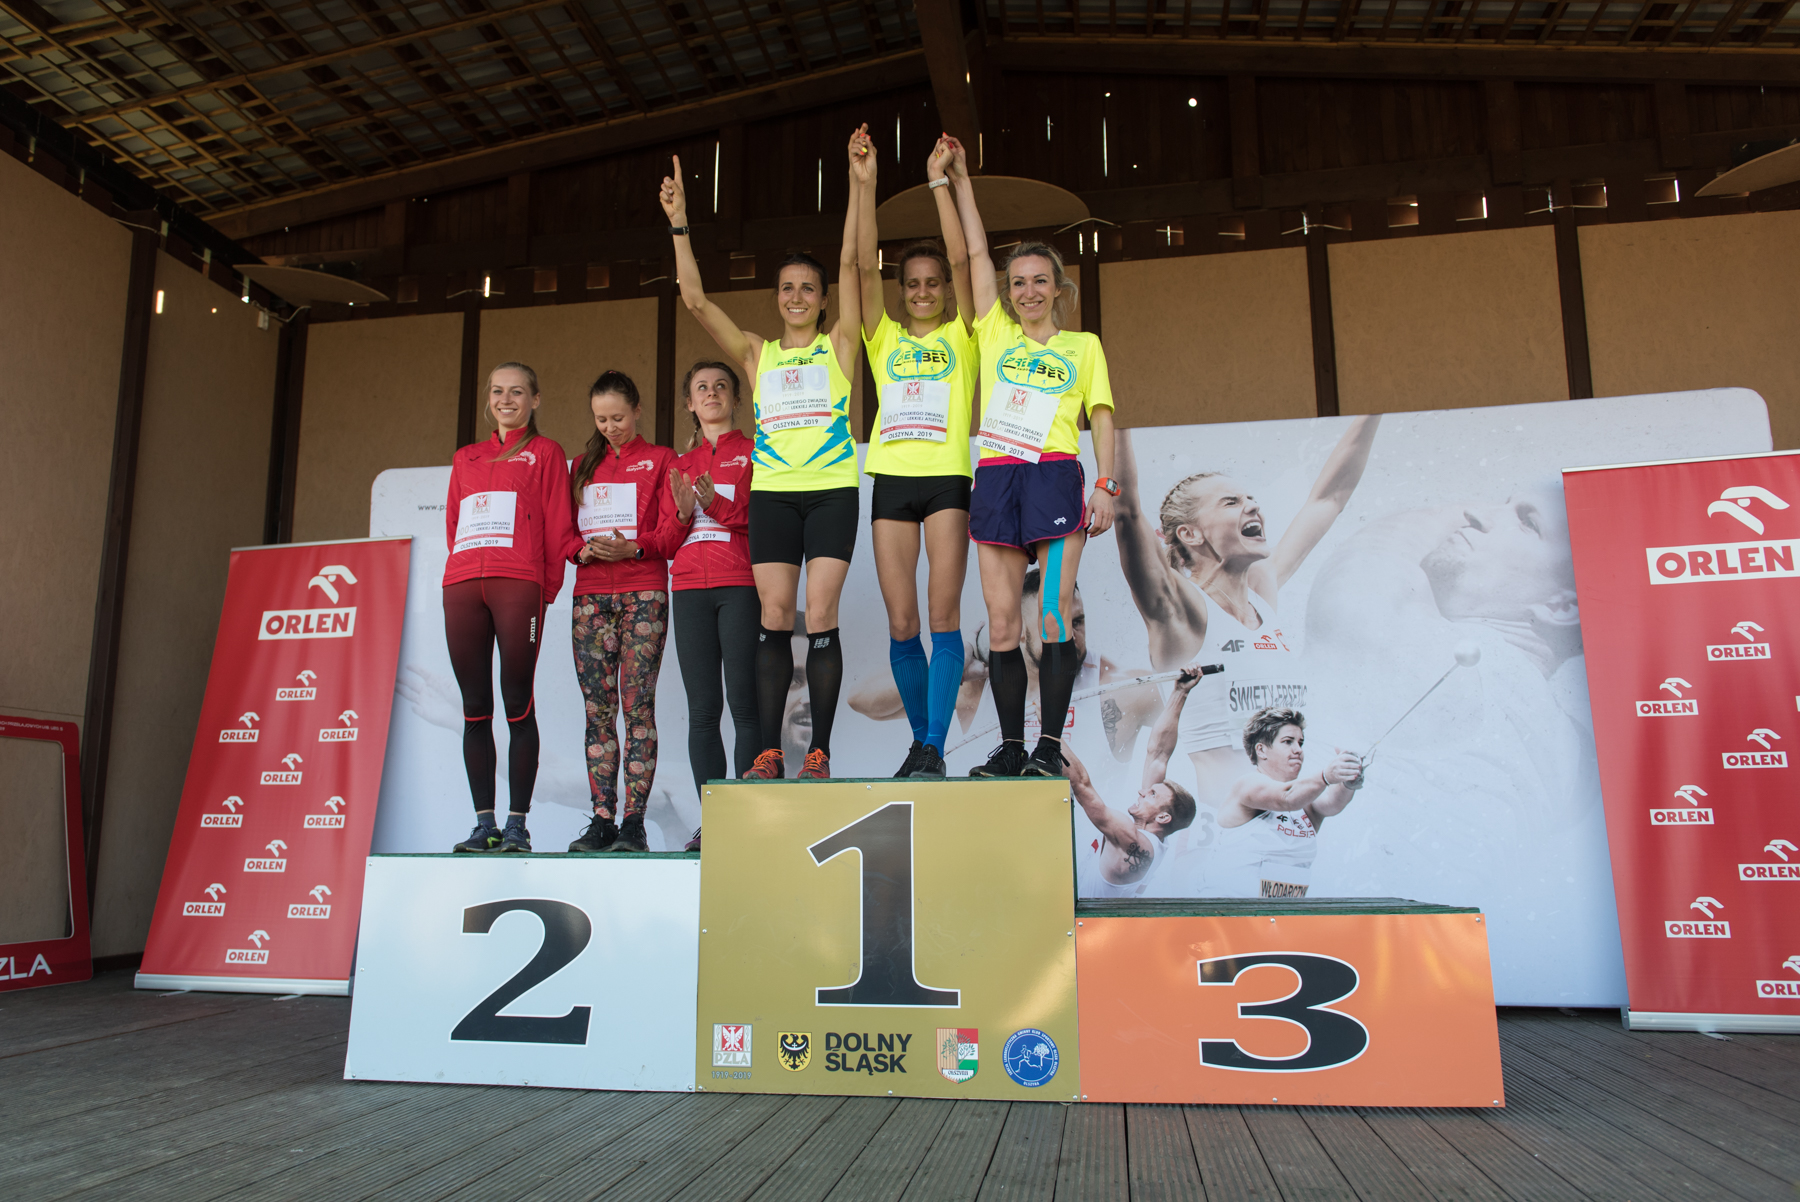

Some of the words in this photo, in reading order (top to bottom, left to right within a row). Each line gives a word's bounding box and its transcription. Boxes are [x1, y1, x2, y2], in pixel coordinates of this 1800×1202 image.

[764, 403, 781, 415] 100
[772, 420, 801, 429] OLSZYNA
[883, 413, 899, 425] 100
[983, 417, 999, 429] 100
[998, 420, 1022, 431] POLSKIEGO
[888, 431, 914, 439] OLSZYNA
[982, 439, 1006, 451] OLSZYNA
[1008, 447, 1025, 457] 2019
[580, 517, 594, 527] 100
[460, 541, 482, 550] OLSZYNA
[1655, 545, 1795, 578] ORLEN
[265, 613, 349, 635] ORLEN
[1710, 645, 1766, 658] ORLEN
[278, 689, 314, 699] ORLEN
[1639, 702, 1694, 714] ORLEN
[221, 731, 256, 742] ORLEN
[321, 729, 355, 740] ORLEN
[1726, 754, 1784, 766] ORLEN
[263, 773, 300, 783] ORLEN
[203, 816, 240, 825] ORLEN
[306, 816, 343, 826] ORLEN
[1653, 811, 1710, 823] ORLEN
[246, 860, 284, 870] ORLEN
[1742, 866, 1800, 878] ORLEN
[185, 904, 223, 914] ORLEN
[806, 801, 961, 1008] 1
[289, 906, 328, 917] ORLEN
[1668, 924, 1726, 935] ORLEN
[228, 951, 266, 962] ORLEN
[449, 897, 593, 1047] 2
[1197, 951, 1369, 1073] 3
[825, 1032, 913, 1052] DOLNY
[714, 1052, 749, 1064] PZLA
[825, 1048, 907, 1076] ŚLĄSK
[712, 1071, 752, 1079] 1919-2019
